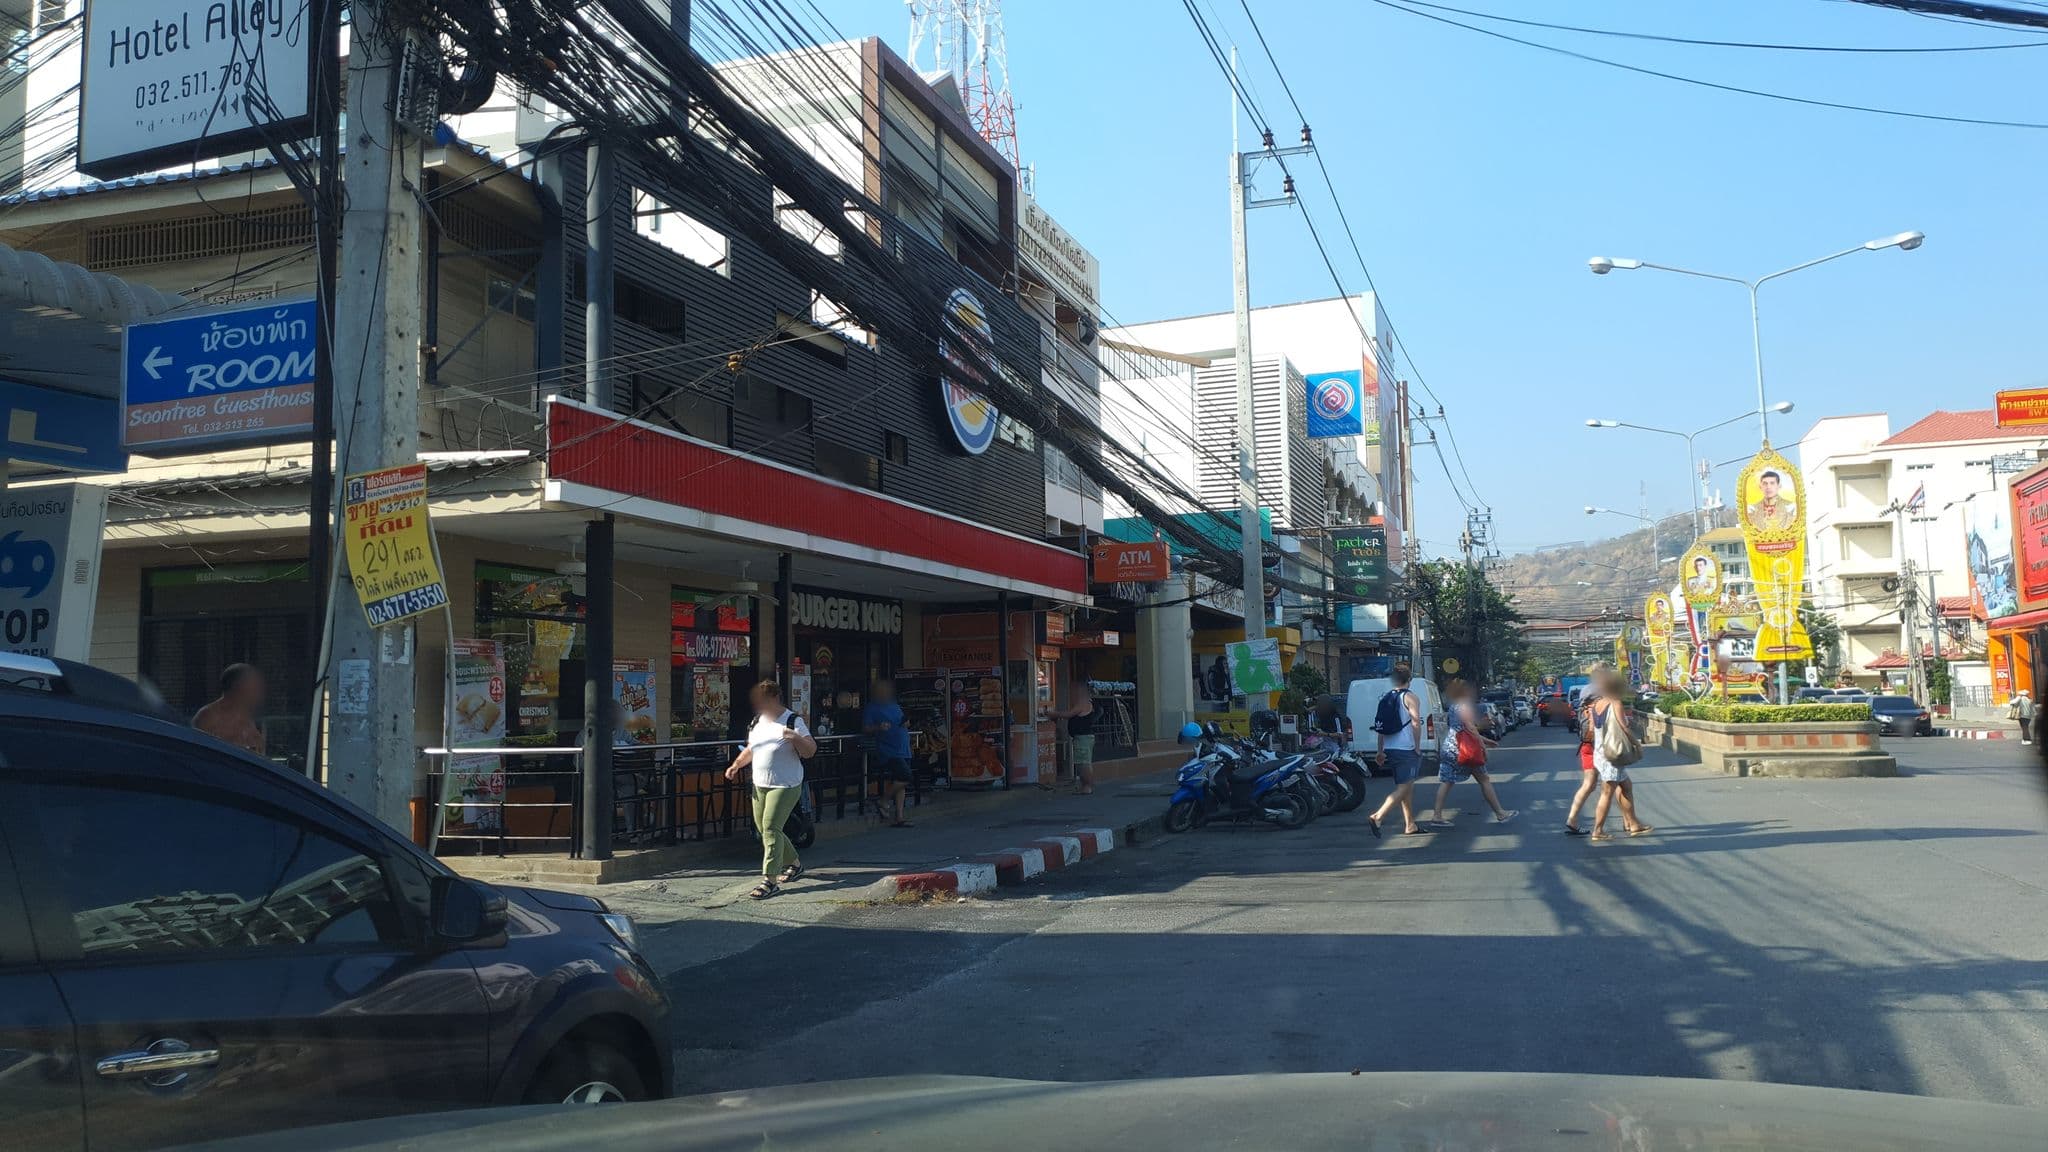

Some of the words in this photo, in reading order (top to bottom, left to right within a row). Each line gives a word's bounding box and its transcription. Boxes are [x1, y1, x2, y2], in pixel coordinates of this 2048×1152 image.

[109, 12, 190, 68] Hotel
[201, 308, 307, 353] ห้องพัก
[128, 400, 207, 428] Soontree
[182, 423, 201, 436] Tel.
[347, 501, 379, 522] ขาย
[360, 515, 413, 540] ที่ดิน
[363, 536, 401, 574] 291
[1118, 550, 1152, 565] ATM
[791, 592, 860, 631] BURGER
[861, 601, 901, 634] KING
